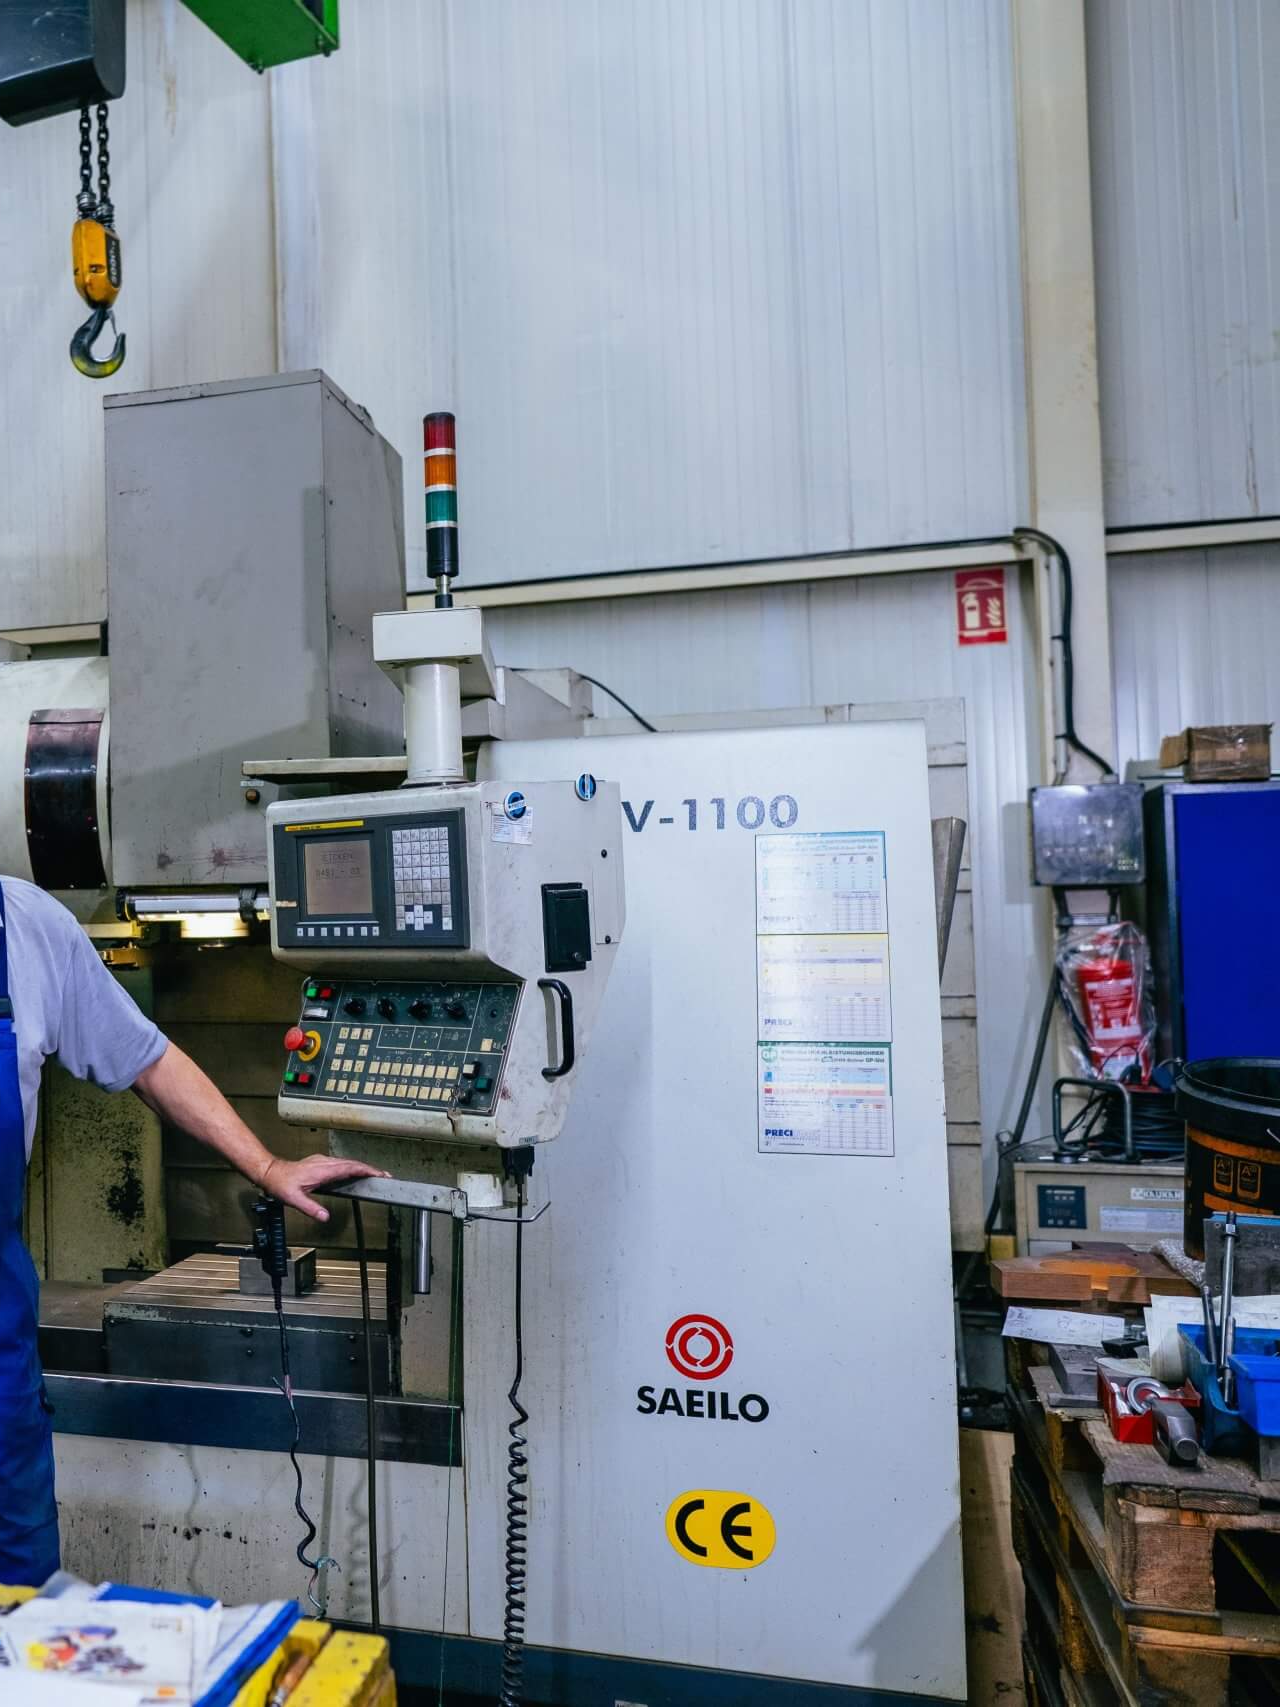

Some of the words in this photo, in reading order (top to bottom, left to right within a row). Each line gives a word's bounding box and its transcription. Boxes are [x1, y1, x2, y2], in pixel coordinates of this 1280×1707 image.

[621, 795, 798, 832] V-1100
[637, 1385, 770, 1423] SAEILO
[675, 1498, 754, 1561] CE
